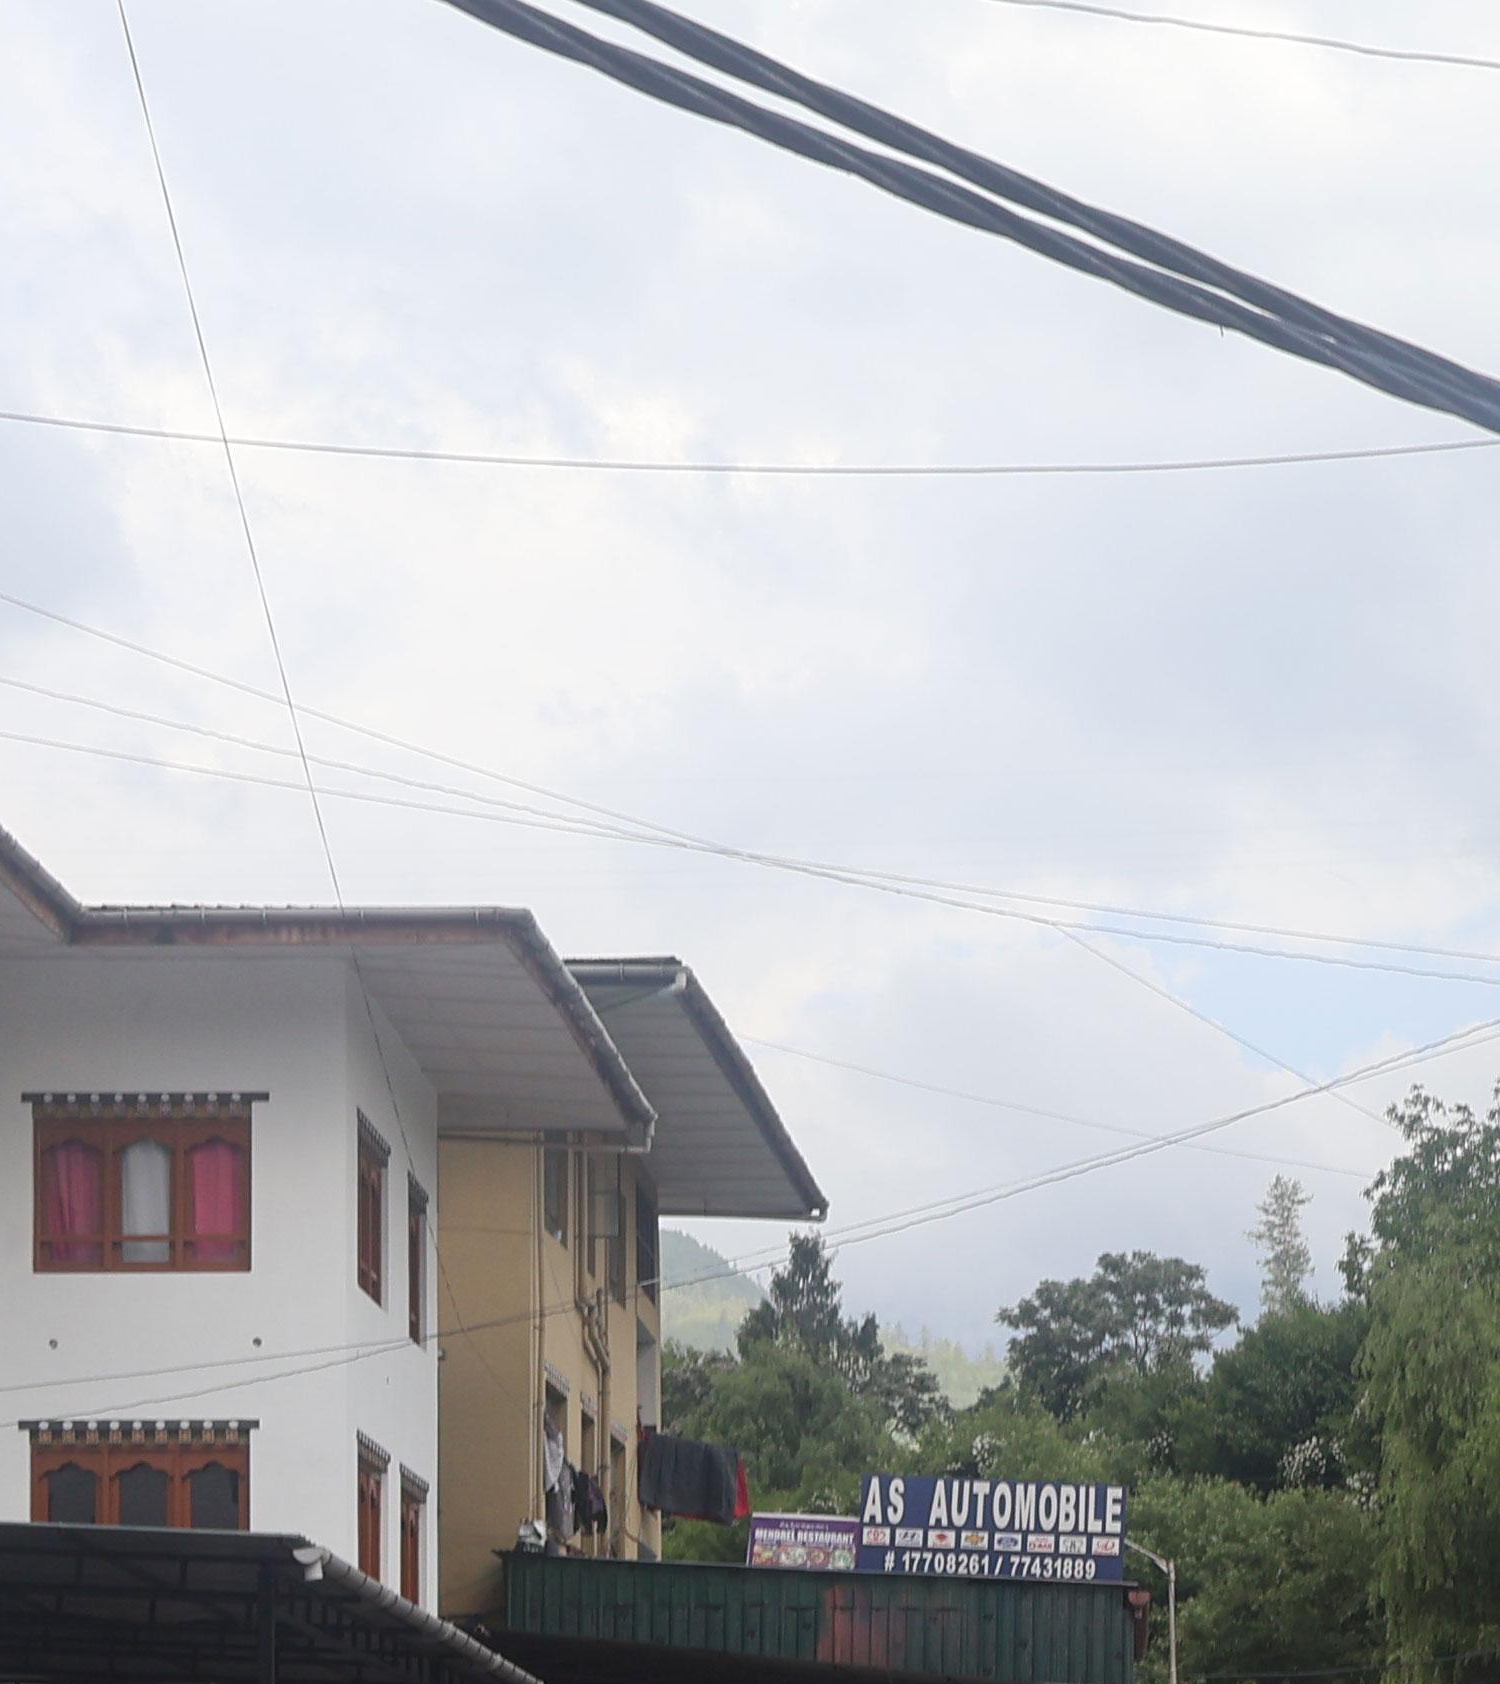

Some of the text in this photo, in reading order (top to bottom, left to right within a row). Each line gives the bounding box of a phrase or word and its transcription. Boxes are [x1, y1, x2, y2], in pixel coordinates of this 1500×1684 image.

[863, 1475, 1123, 1535] AS AUTOMOBILE
[797, 1529, 855, 1546] RESTAURANT
[884, 1552, 895, 1573] #
[902, 1551, 989, 1576] 17708261
[1010, 1556, 1097, 1581] 77431889
